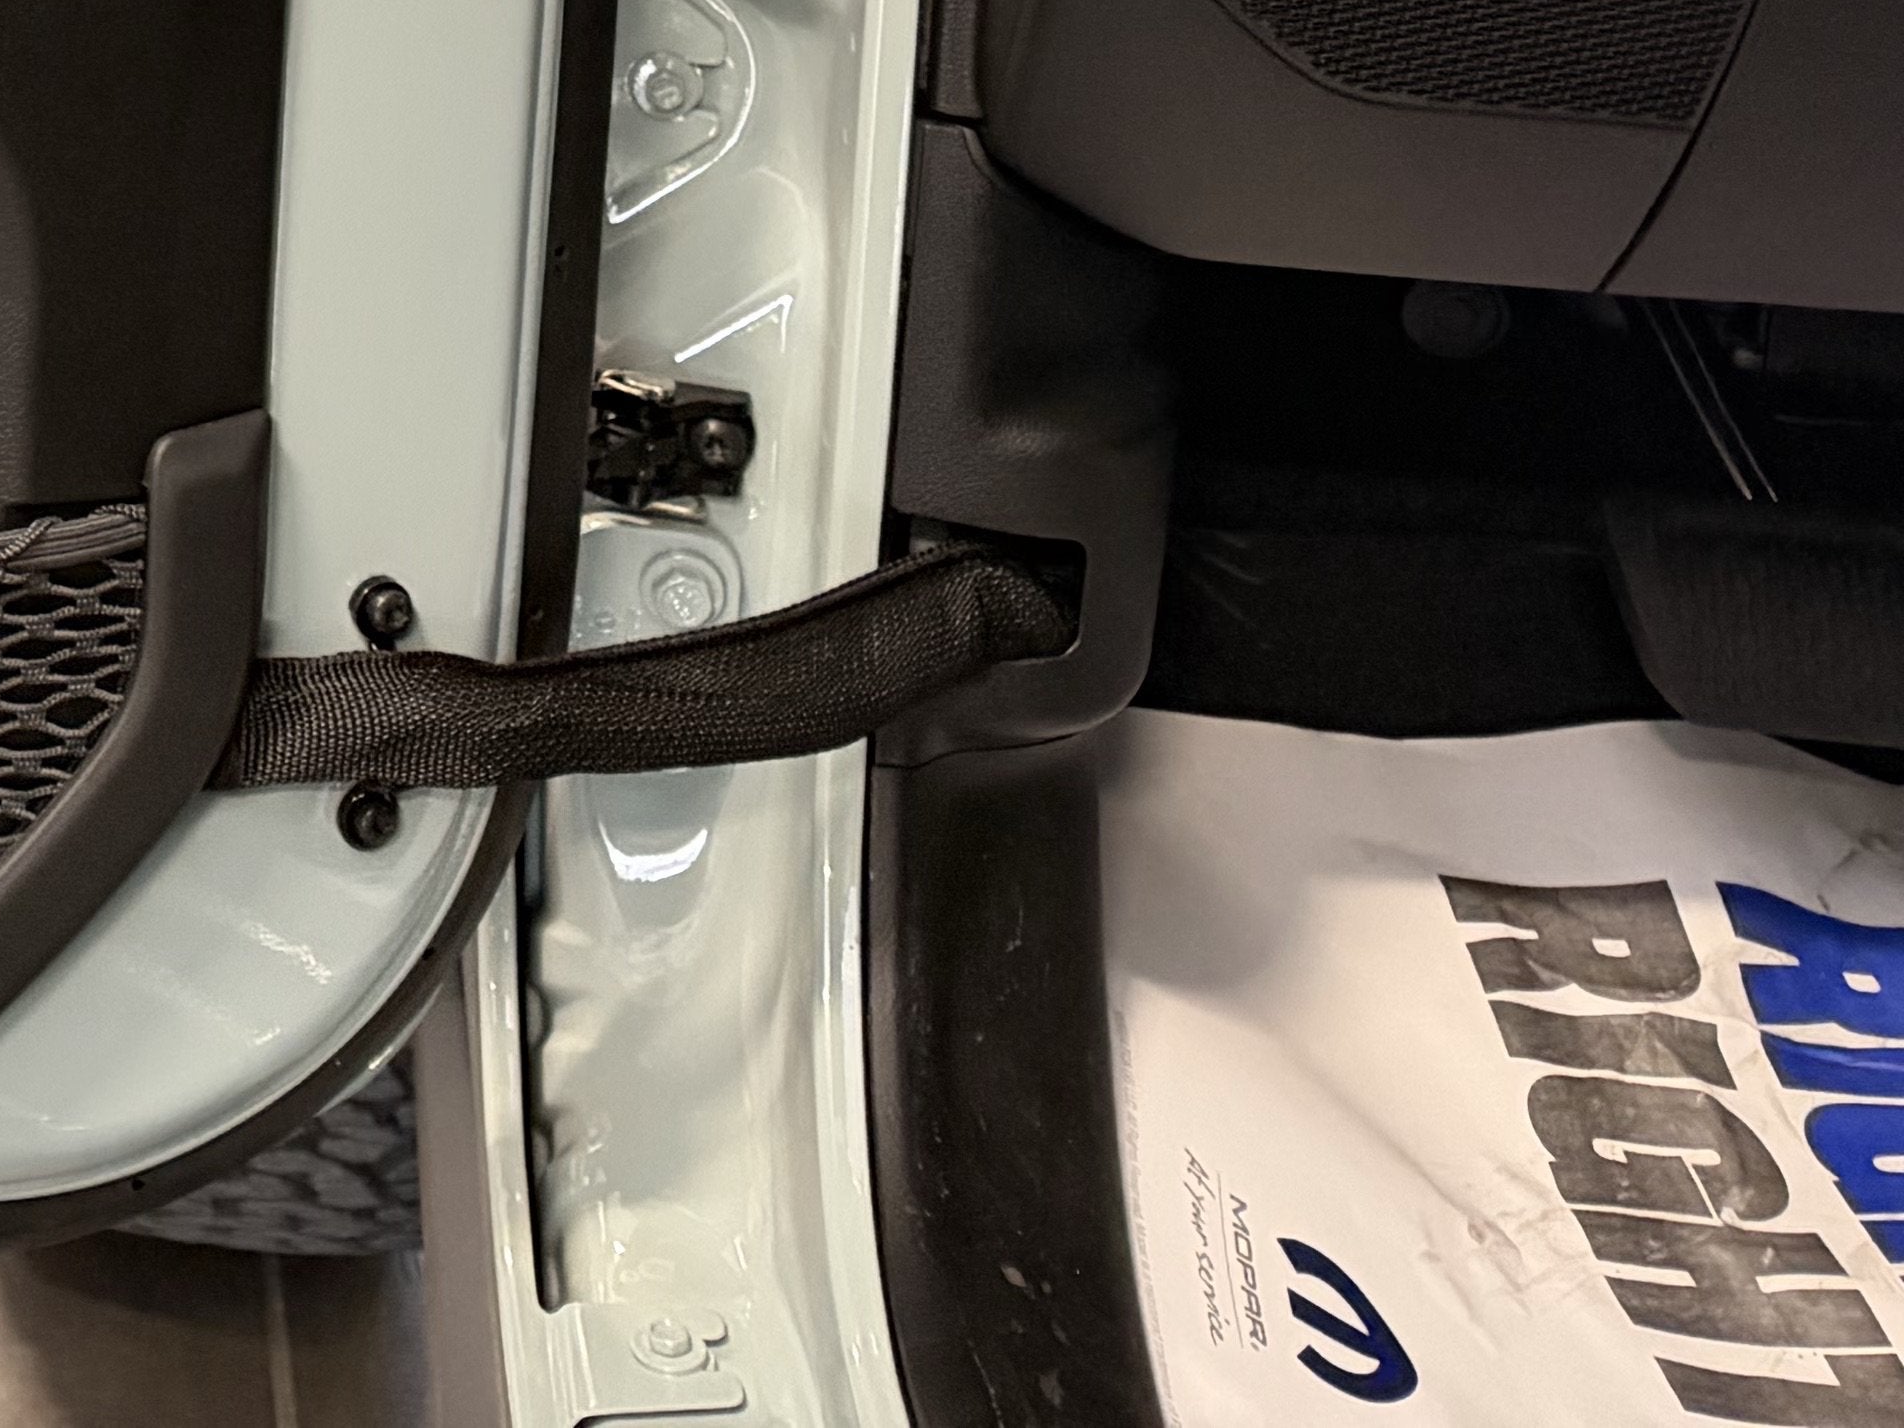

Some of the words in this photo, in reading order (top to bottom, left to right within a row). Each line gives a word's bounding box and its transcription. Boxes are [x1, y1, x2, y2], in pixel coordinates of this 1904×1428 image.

[1183, 1147, 1216, 1200] At
[1183, 1181, 1210, 1248] your
[1195, 1251, 1230, 1347] service
[1228, 1192, 1267, 1347] MOPAR
